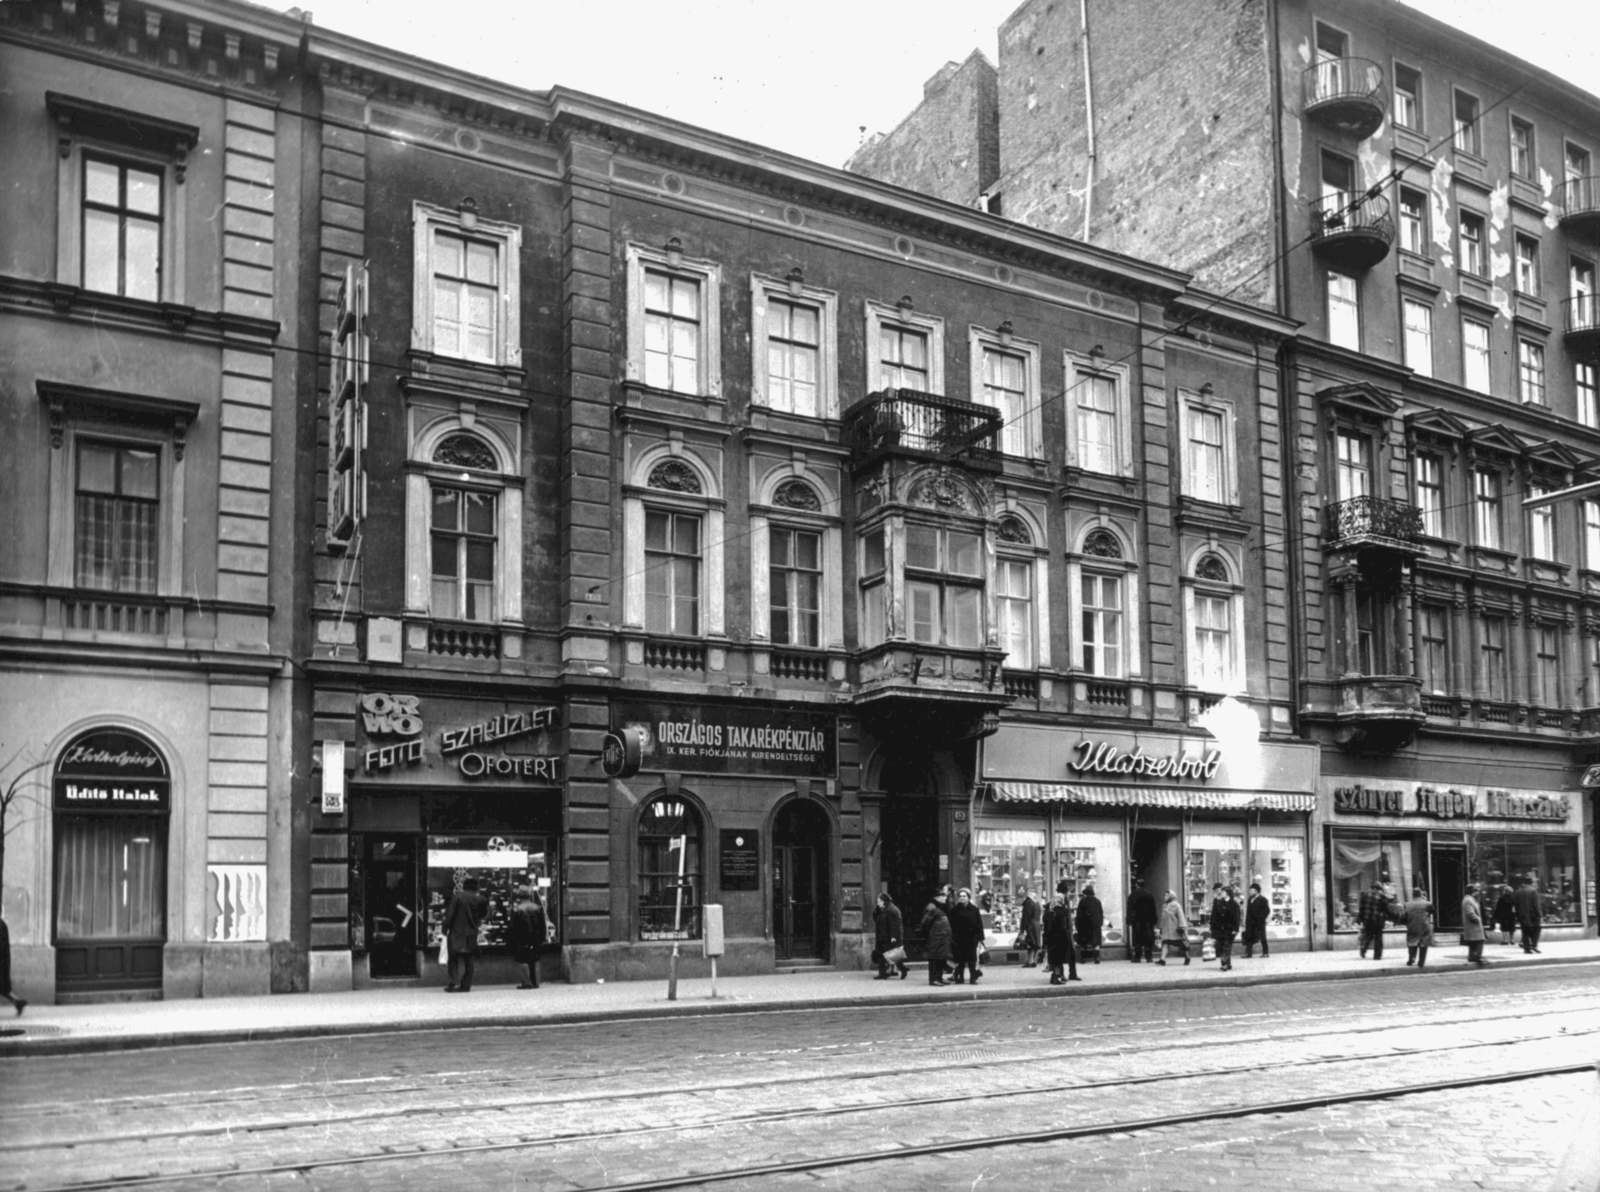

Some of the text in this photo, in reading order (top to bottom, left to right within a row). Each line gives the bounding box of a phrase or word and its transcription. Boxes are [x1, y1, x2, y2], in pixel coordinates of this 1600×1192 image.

[658, 719, 825, 752] ORSZÁGOS TAKARÉKPÉNZTÁR
[365, 739, 424, 771] FOTO
[666, 747, 816, 762] IX. KER. FIÓKJÁNAK KIRENDELTSÉGE
[1071, 740, 1223, 779] Illatszerbolt
[112, 788, 160, 801] Italok
